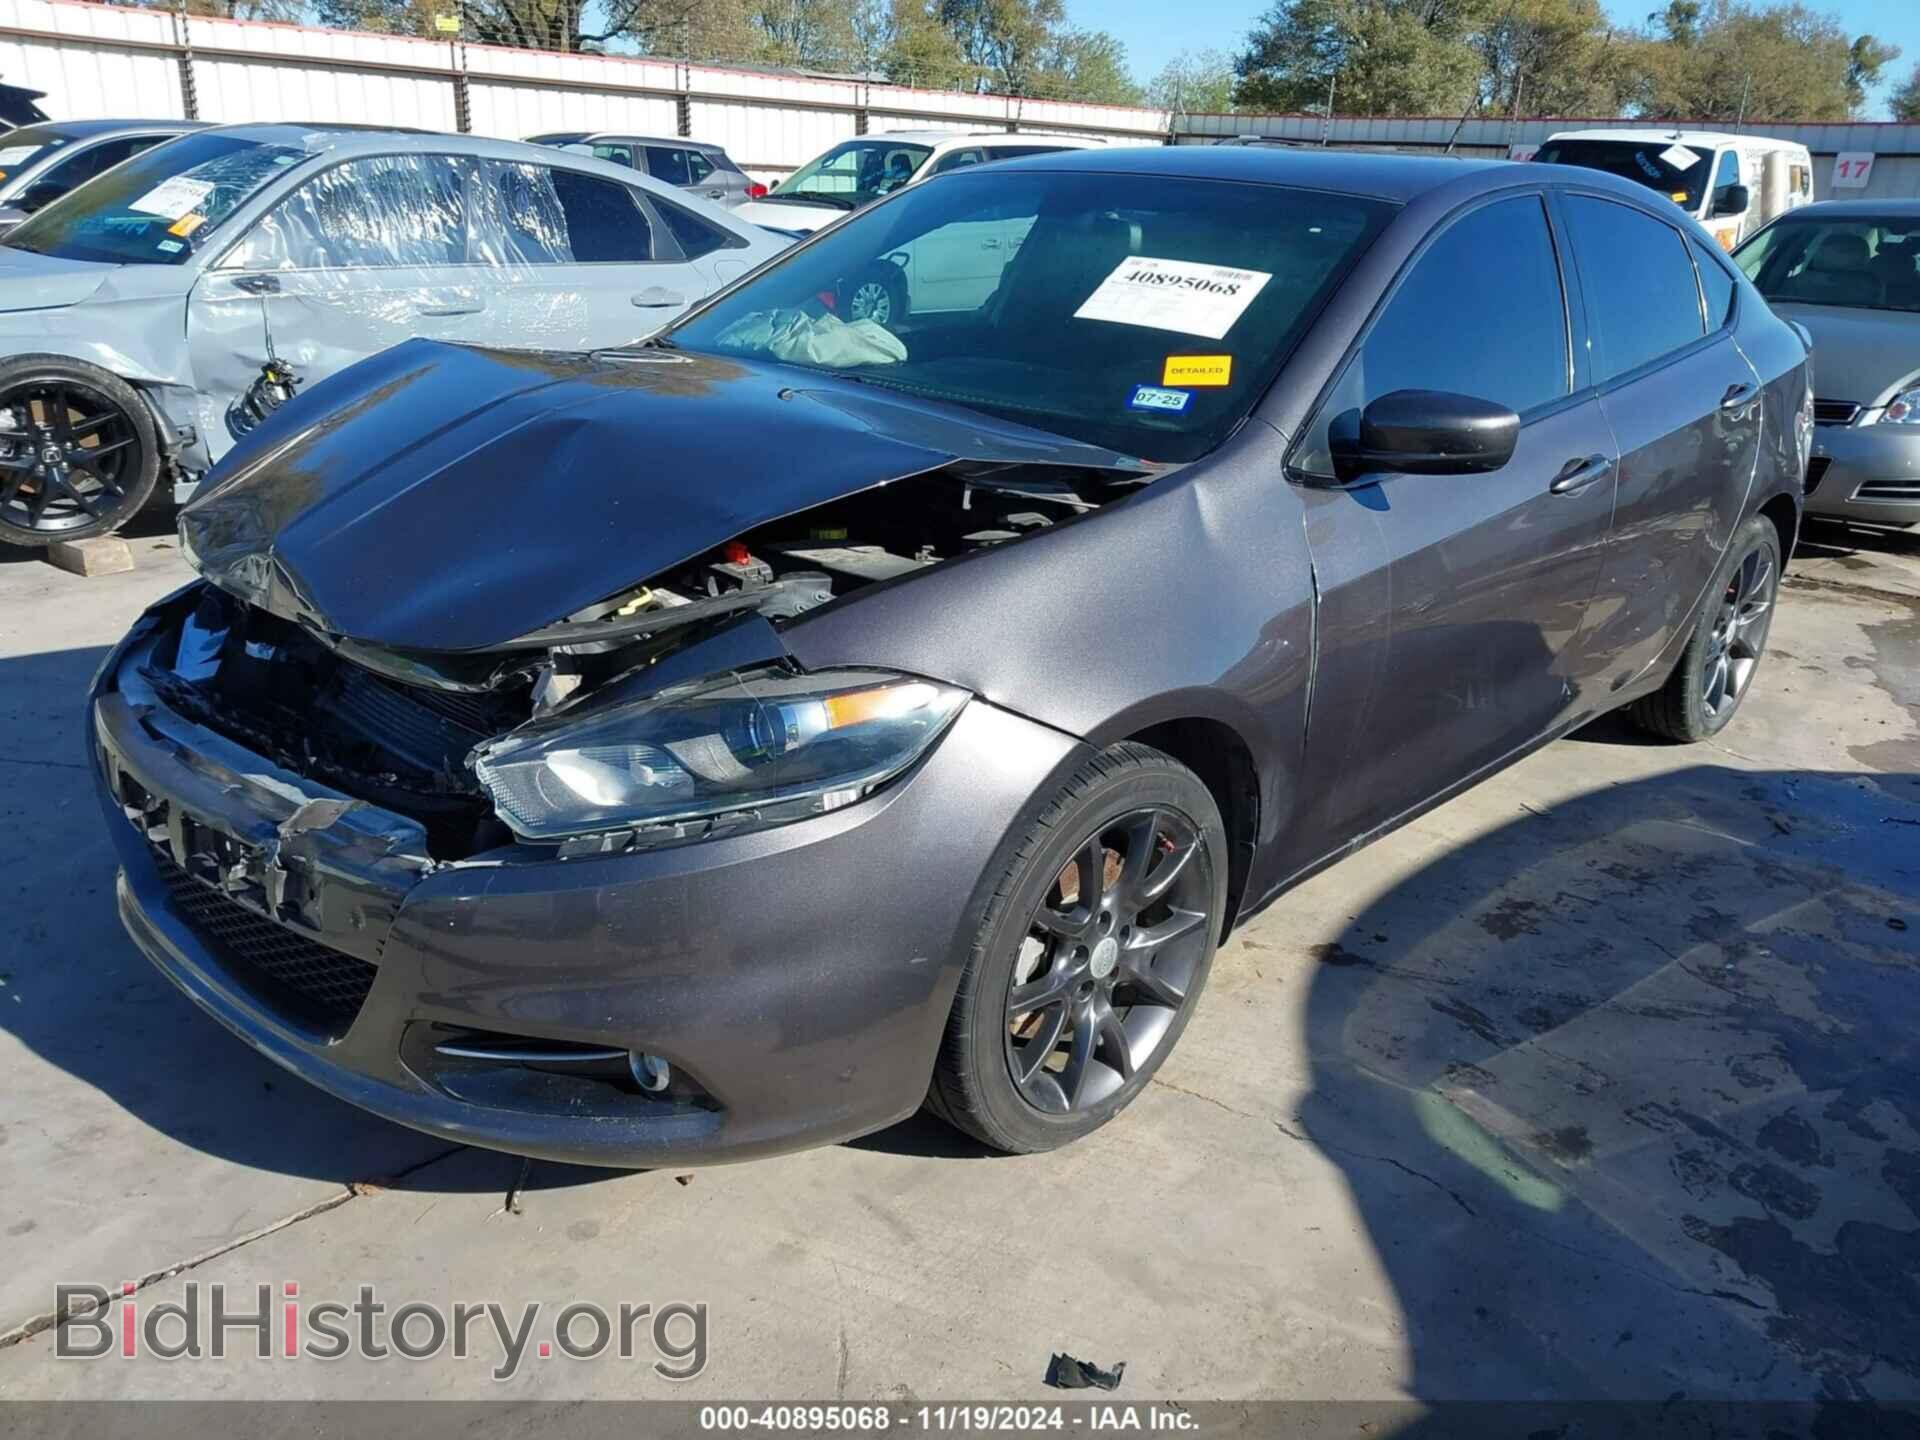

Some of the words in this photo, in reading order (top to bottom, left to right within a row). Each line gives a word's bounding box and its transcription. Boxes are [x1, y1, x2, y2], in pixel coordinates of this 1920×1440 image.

[1839, 160, 1869, 178] 17
[1124, 270, 1241, 296] 40895068
[1170, 366, 1224, 375] DETAILED
